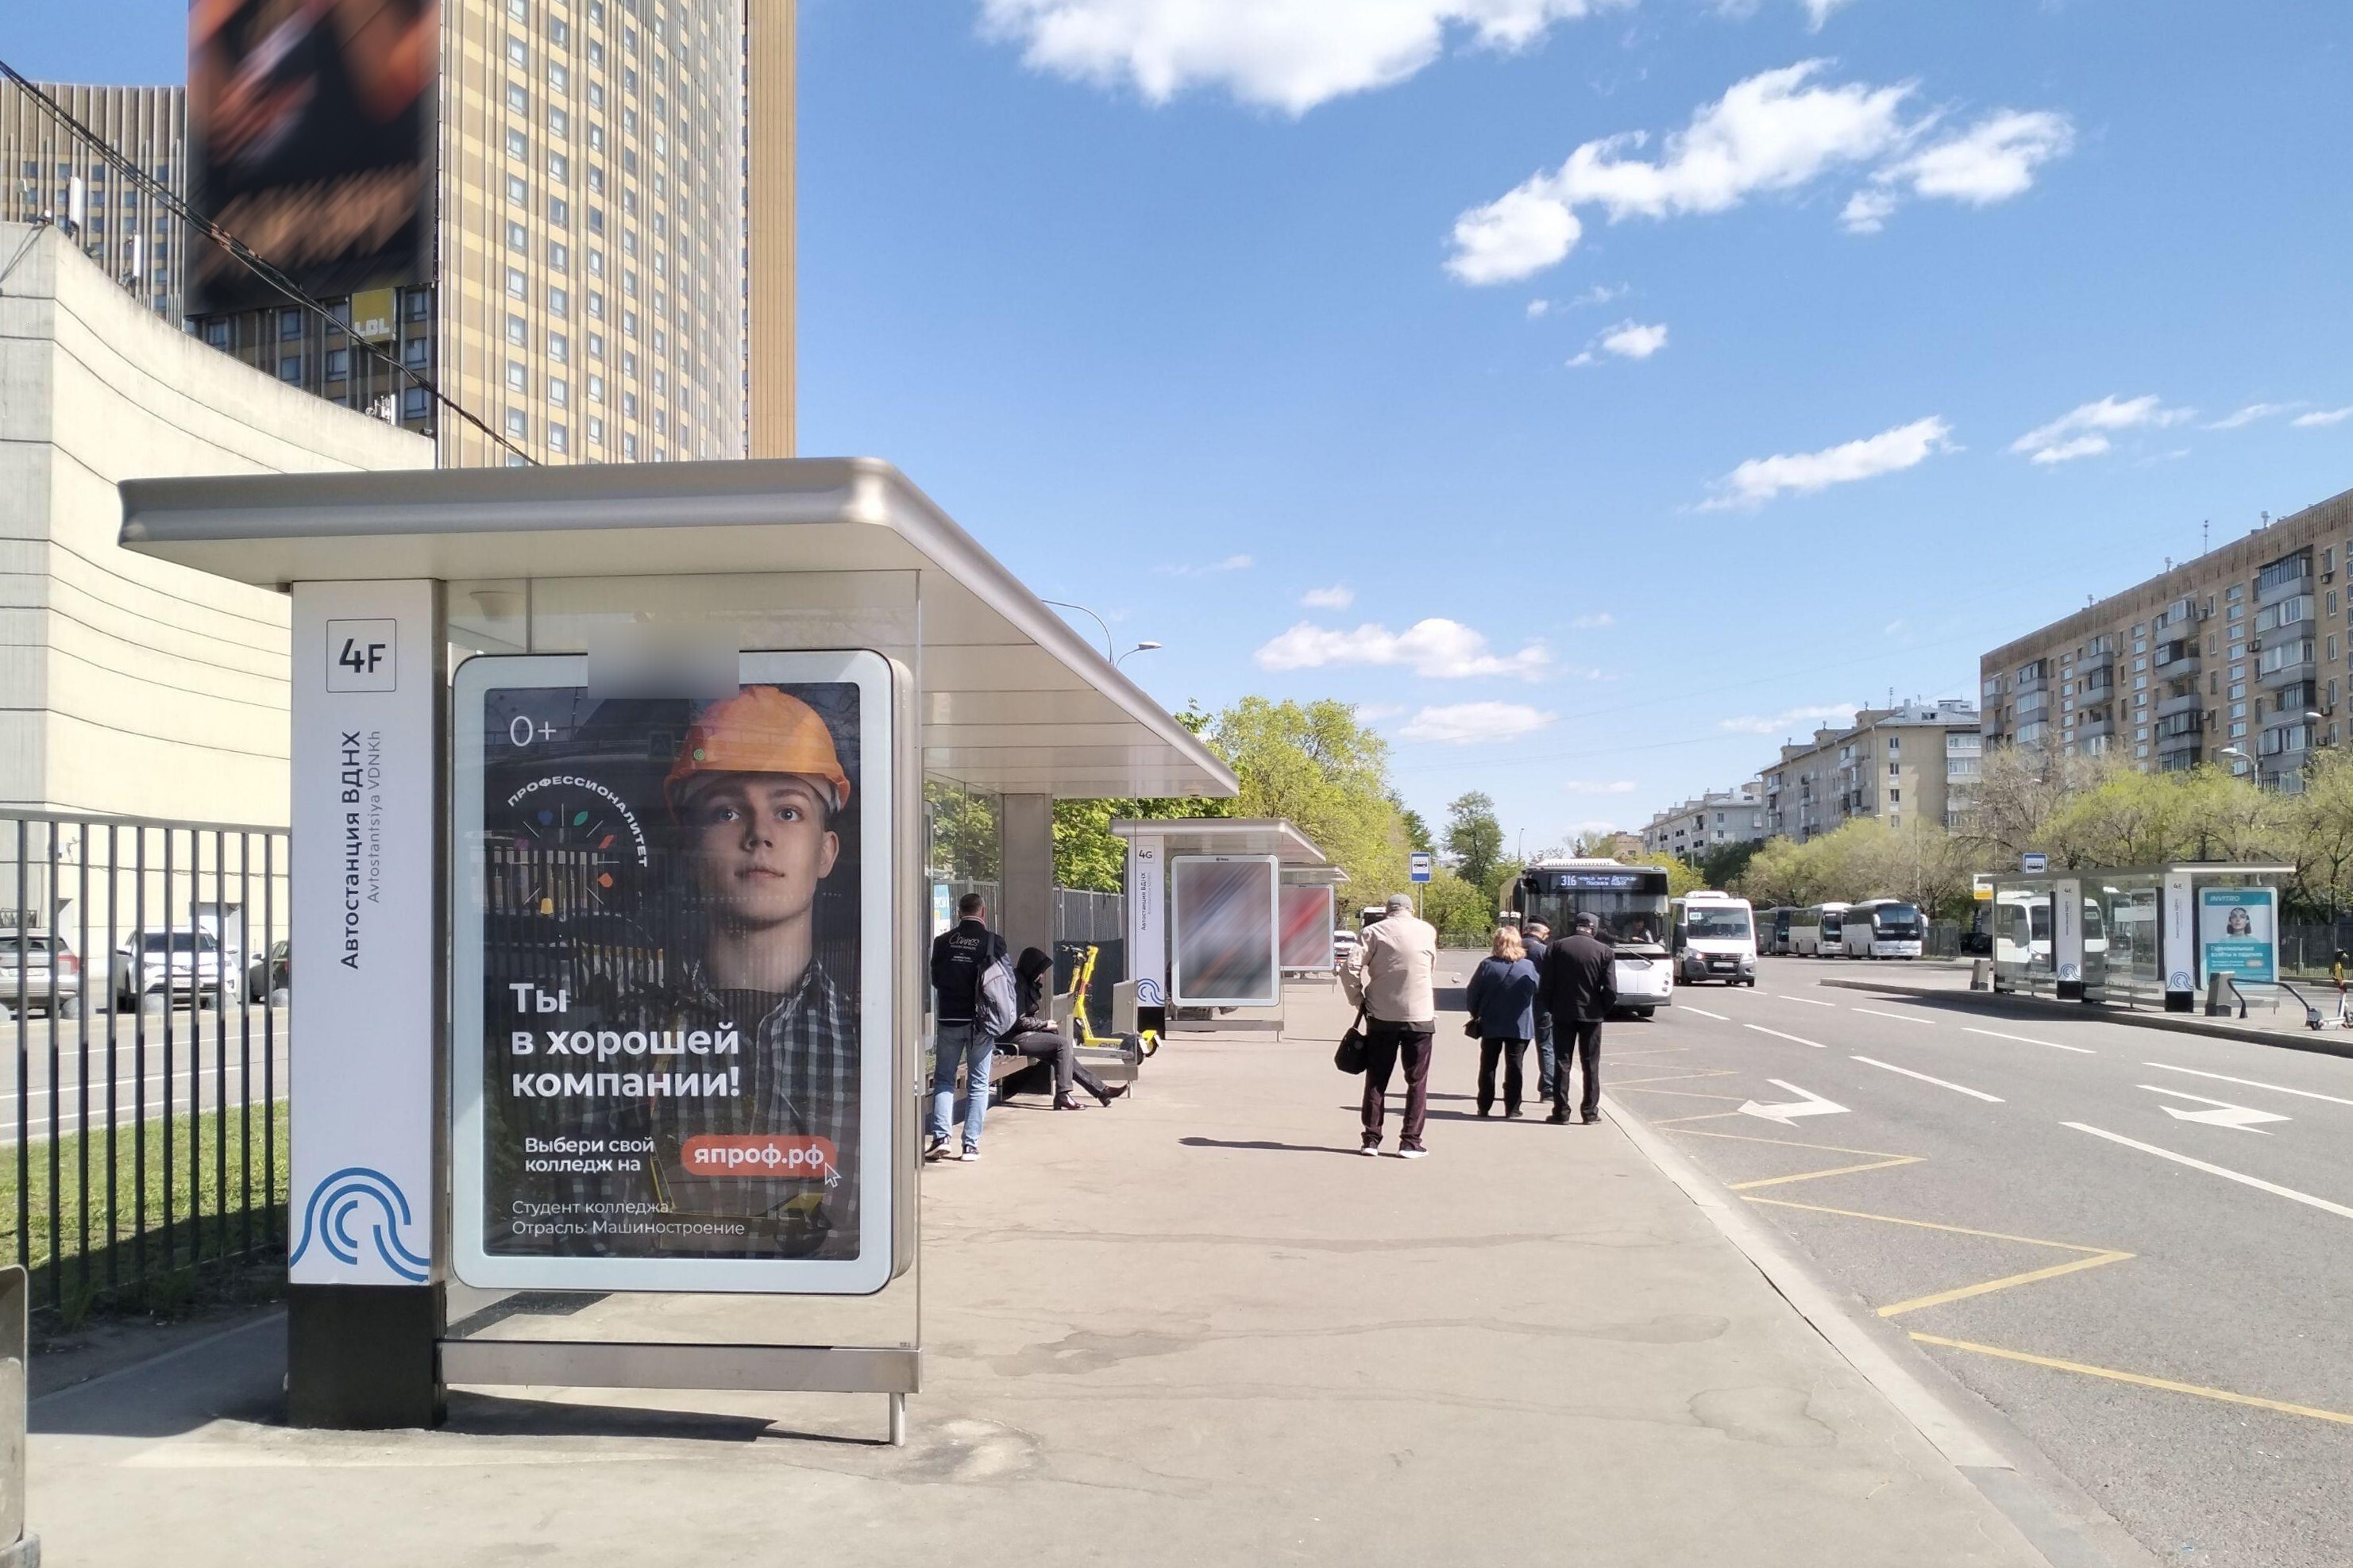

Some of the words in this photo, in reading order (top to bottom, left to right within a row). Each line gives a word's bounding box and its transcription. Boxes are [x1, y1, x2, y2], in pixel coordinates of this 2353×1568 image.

[339, 638, 386, 673] 4F
[510, 716, 556, 746] 0+
[341, 730, 364, 803] ВДНХ
[367, 731, 380, 790] VDNKh
[507, 776, 648, 867] ПРОФЕССИОНАЛИТЕТ
[367, 796, 383, 903] Avtostantsiya
[1138, 849, 1153, 859] 4G
[341, 813, 361, 970] Автостанция
[1560, 875, 1577, 886] 316
[509, 983, 567, 1013] Ты
[512, 1031, 534, 1055] в
[546, 1022, 739, 1062] хорошей
[512, 1066, 740, 1097] компании!
[525, 1137, 604, 1154] Выбери
[608, 1136, 654, 1153] свой
[694, 1143, 824, 1169] япроф.рф
[525, 1157, 613, 1173] колледж
[621, 1159, 641, 1172] на
[512, 1200, 581, 1217] Студент
[512, 1221, 588, 1237] Отрасль:
[592, 1221, 745, 1237] Машиностроение
